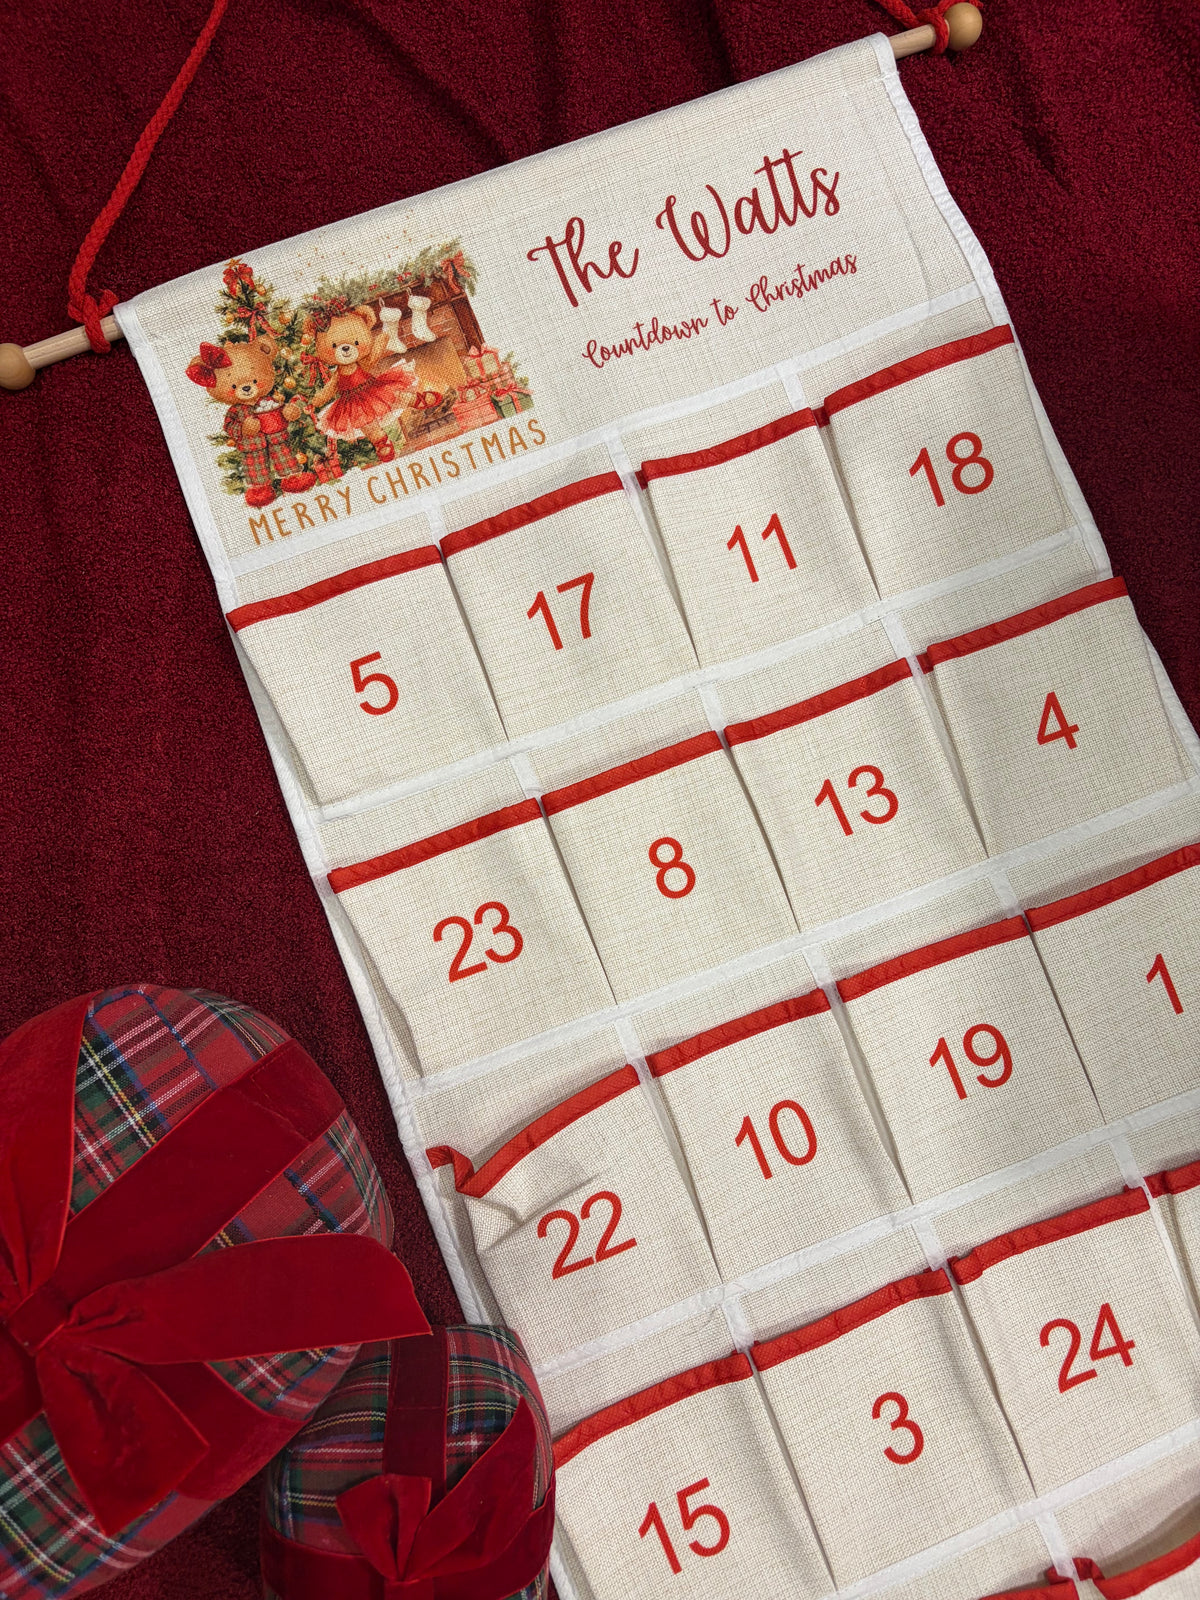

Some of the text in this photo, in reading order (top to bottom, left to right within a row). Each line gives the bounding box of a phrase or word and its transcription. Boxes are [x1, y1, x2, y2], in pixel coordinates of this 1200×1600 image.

[527, 149, 840, 307] The Watts
[582, 253, 857, 368] Countdown to Christmas
[248, 419, 547, 546] MERRY CHRISTMAS
[909, 432, 994, 507] 18
[727, 513, 797, 582] 11
[527, 572, 594, 650] 17
[350, 652, 399, 715] 5
[1037, 692, 1079, 749] 4
[815, 765, 898, 836] 13
[649, 837, 696, 899] 8
[433, 902, 523, 983] 23
[1146, 954, 1183, 1014] 1
[929, 1024, 1013, 1100] 19
[735, 1100, 817, 1179] 10
[537, 1191, 637, 1280] 22
[1040, 1303, 1135, 1393] 24
[872, 1392, 924, 1464] 3
[638, 1478, 730, 1574] 15
